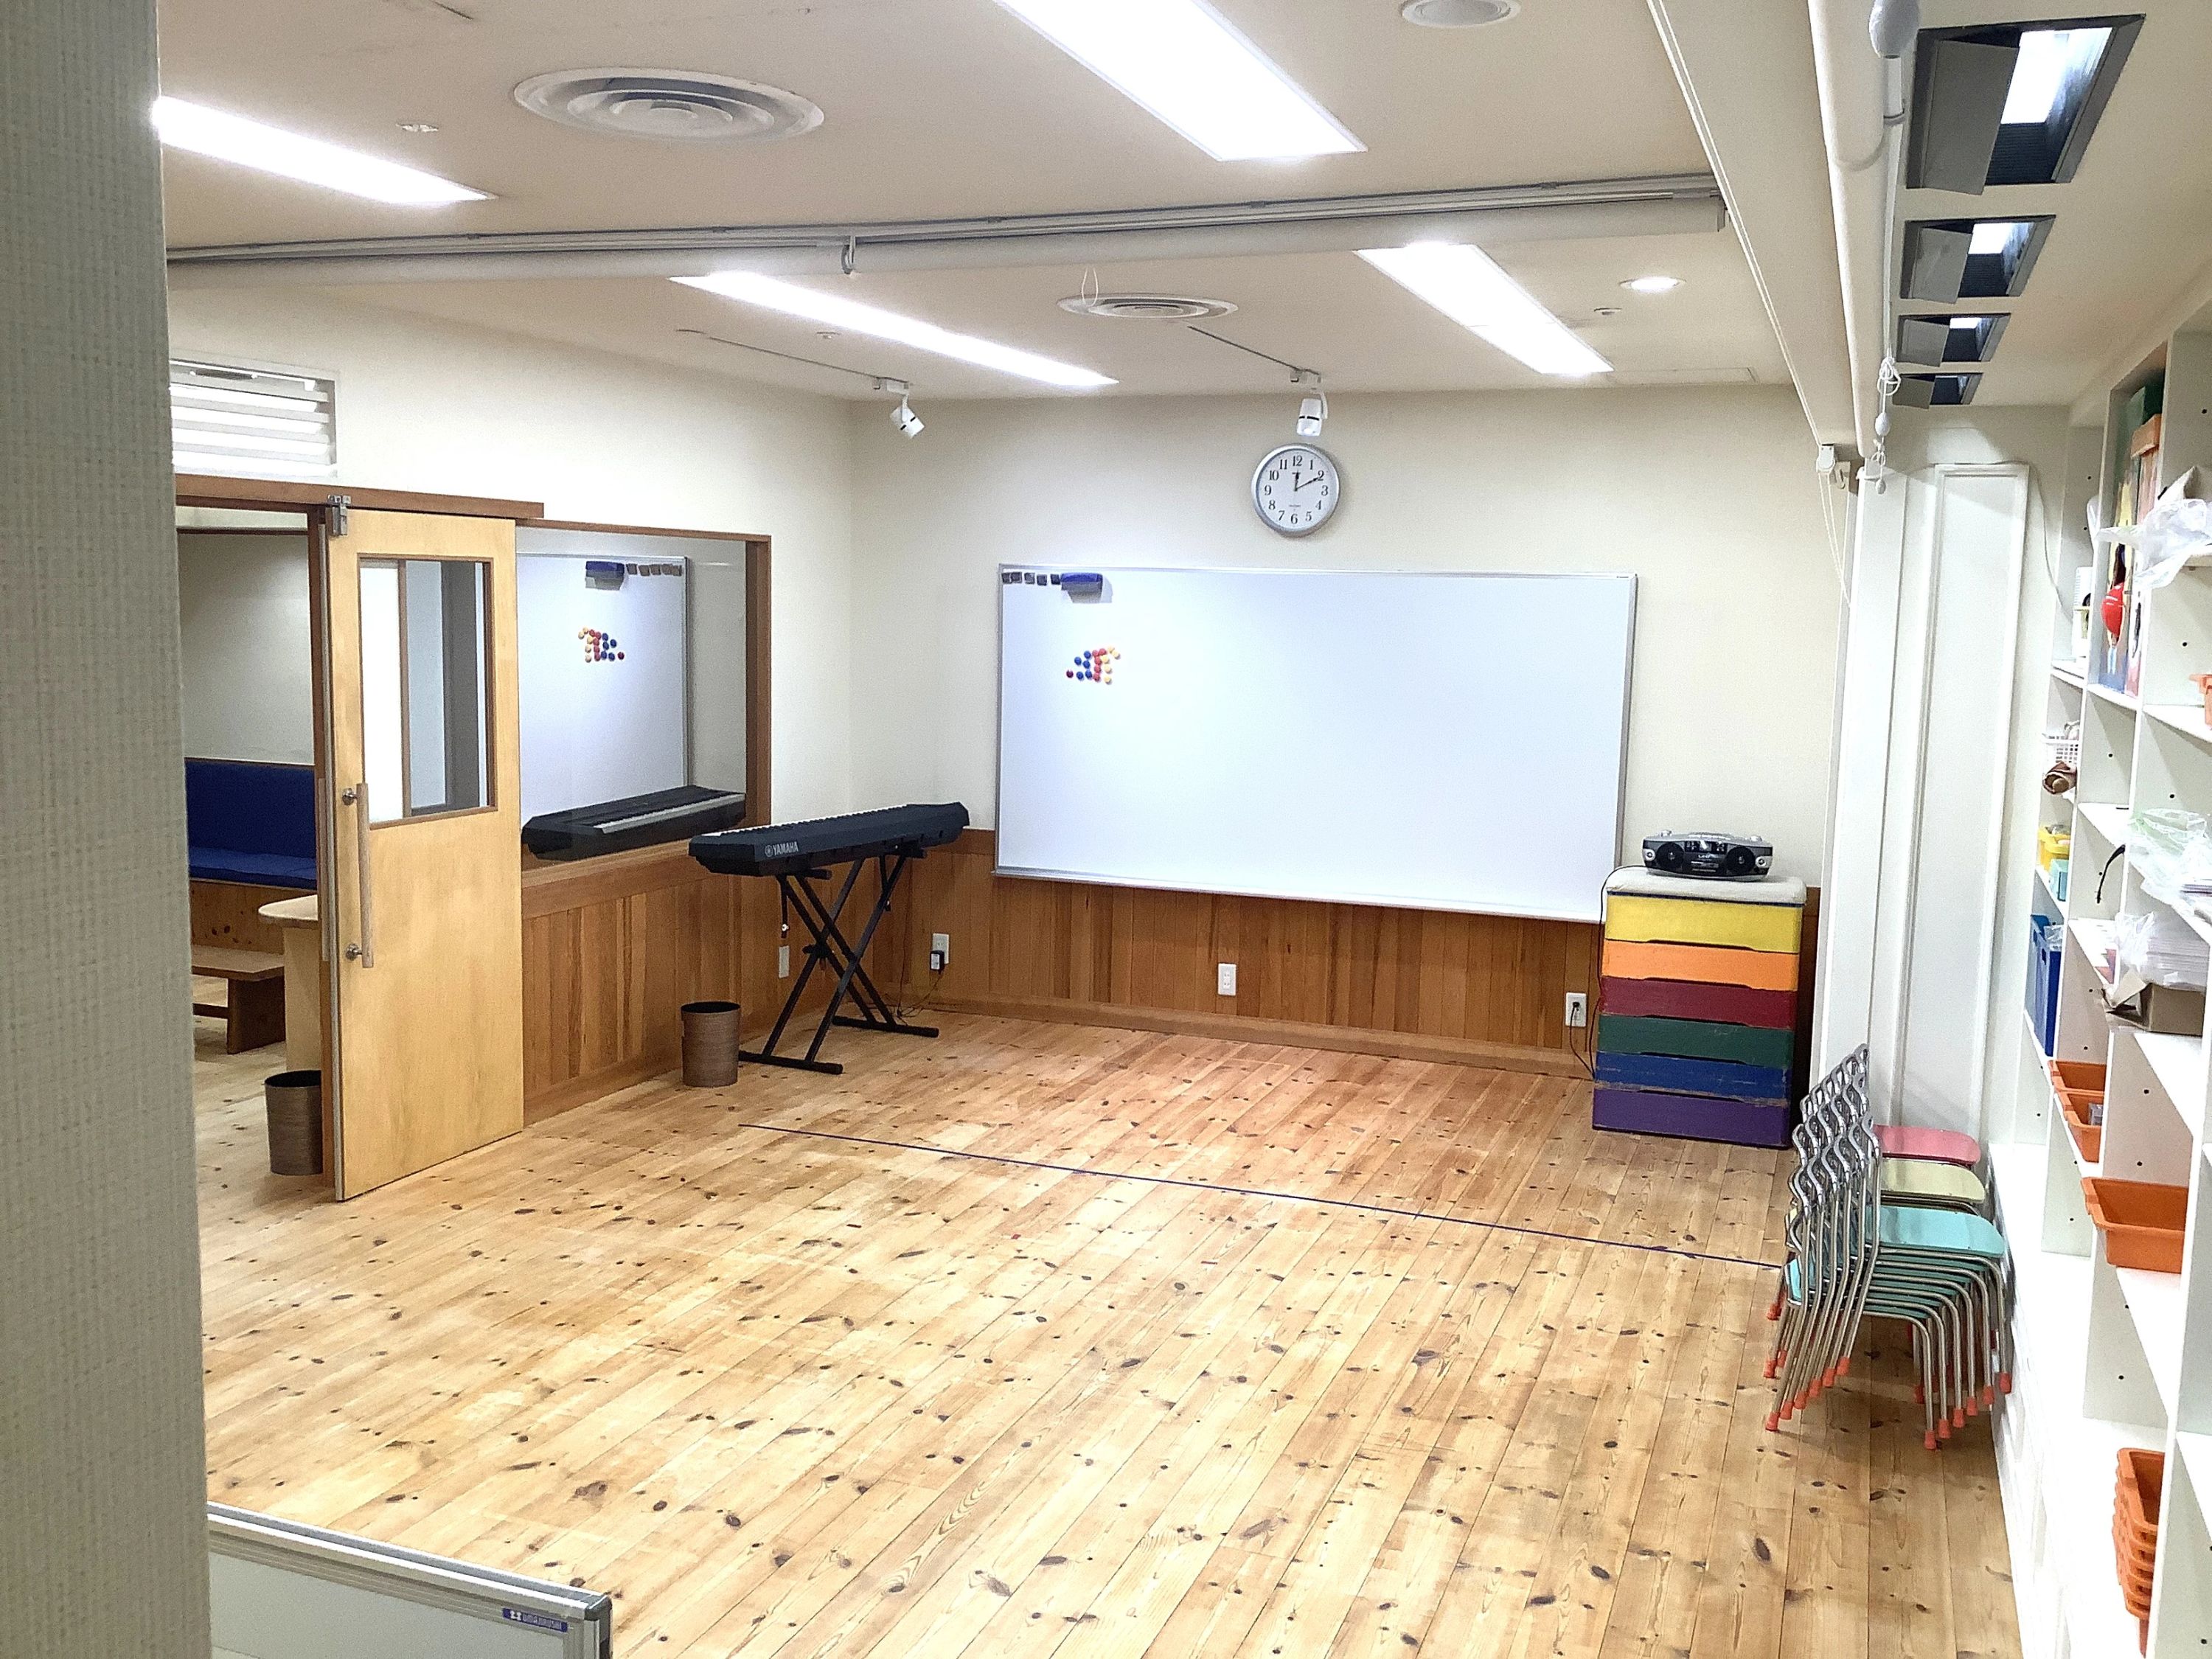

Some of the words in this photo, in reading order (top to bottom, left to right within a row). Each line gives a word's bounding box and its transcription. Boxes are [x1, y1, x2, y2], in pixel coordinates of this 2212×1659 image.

[1280, 459, 1287, 470] 11
[1293, 456, 1303, 466] 12
[1310, 459, 1313, 470] 1
[1269, 470, 1279, 481] 10
[1318, 470, 1324, 481] 2
[1265, 485, 1271, 495] 9
[1321, 485, 1328, 495] 3
[1268, 500, 1276, 509] 8
[1315, 500, 1321, 509] 4
[1279, 510, 1284, 521] 7
[1291, 513, 1298, 524] 6
[1306, 512, 1312, 521] 5
[773, 841, 799, 855] YAMAHA
